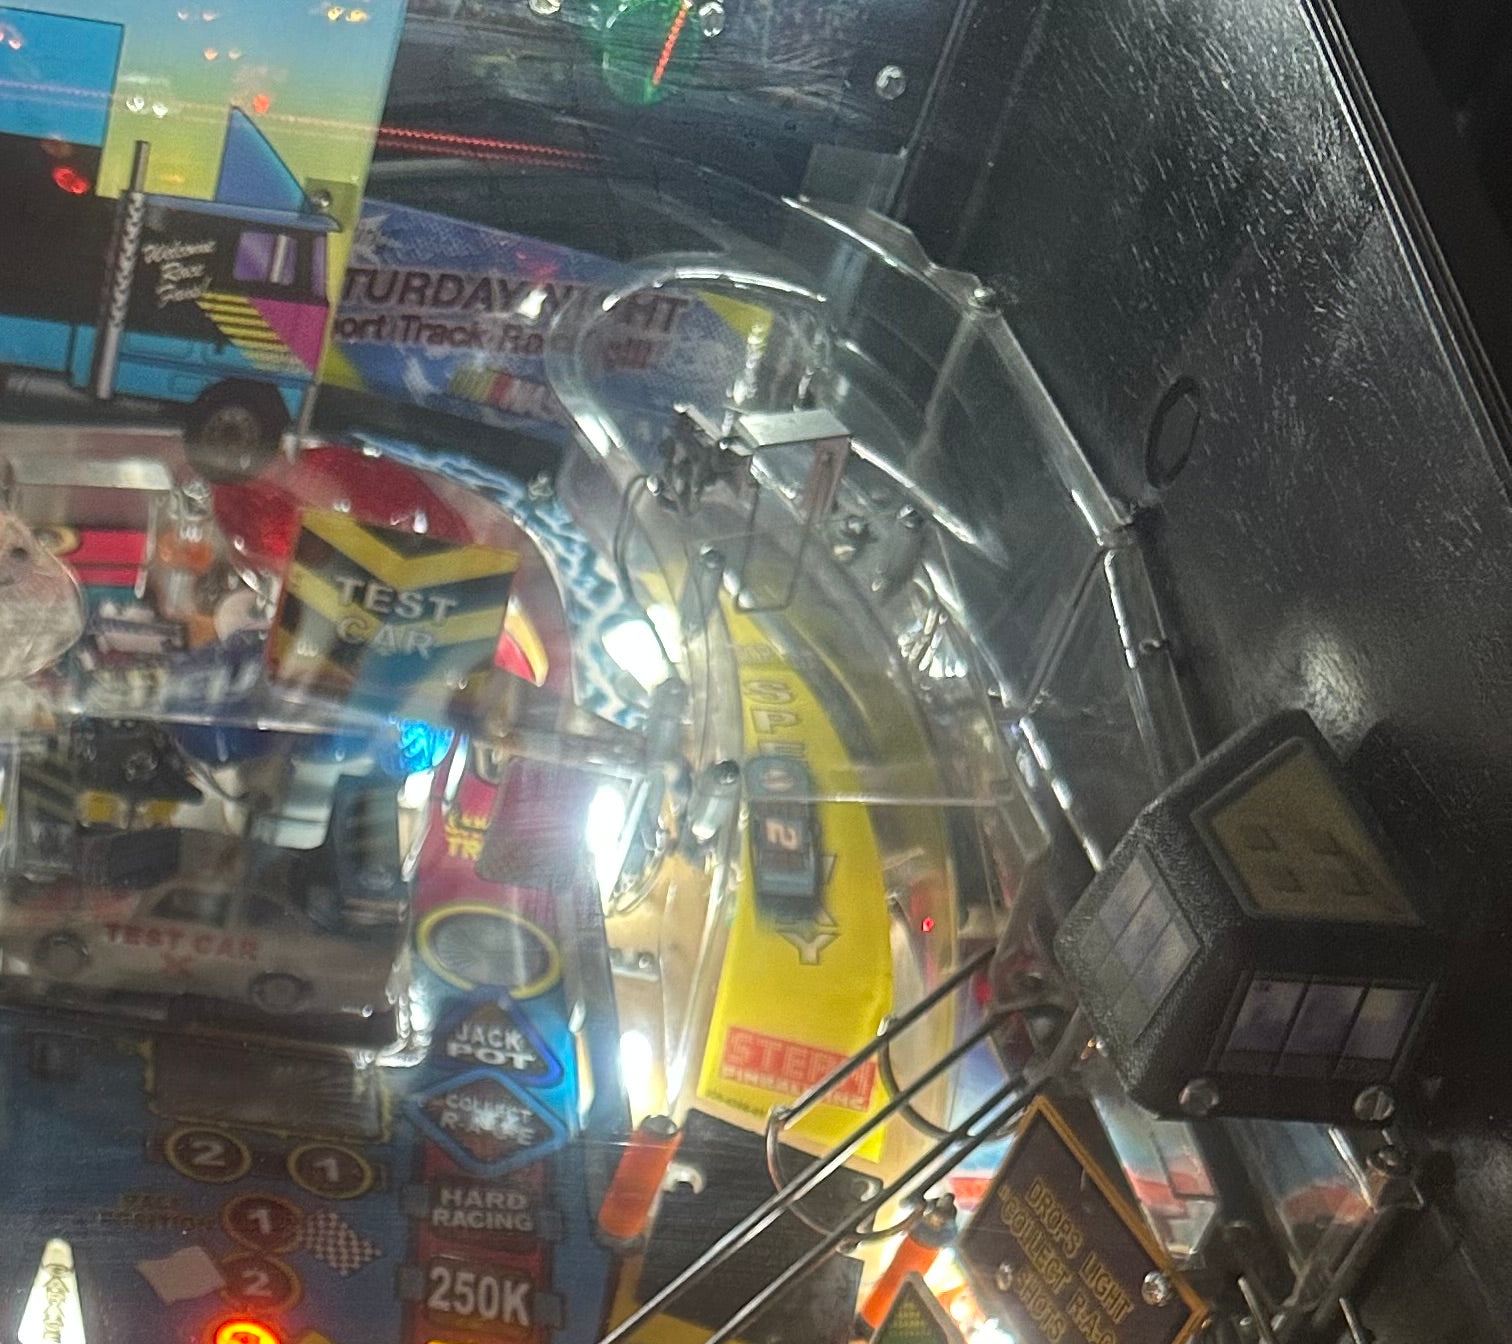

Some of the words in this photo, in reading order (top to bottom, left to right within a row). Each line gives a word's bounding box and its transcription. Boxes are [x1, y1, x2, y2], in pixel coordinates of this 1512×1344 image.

[401, 315, 488, 347] Track
[336, 576, 458, 625] TEST
[338, 615, 435, 660] CAR
[105, 922, 185, 948] TEST
[193, 933, 258, 961] CAR
[455, 1021, 522, 1052] JACK
[446, 1041, 537, 1070] POT
[190, 1140, 227, 1168] 2
[313, 1156, 339, 1183] 1
[440, 1188, 527, 1212] HARD
[247, 1207, 271, 1236] 1
[432, 1208, 535, 1233] RACING
[1025, 1176, 1083, 1259] DROPS
[1078, 1250, 1136, 1325] LIGHT
[241, 1270, 274, 1298] 2
[428, 1266, 532, 1326] 250K
[1015, 1267, 1067, 1344] SHOTS
